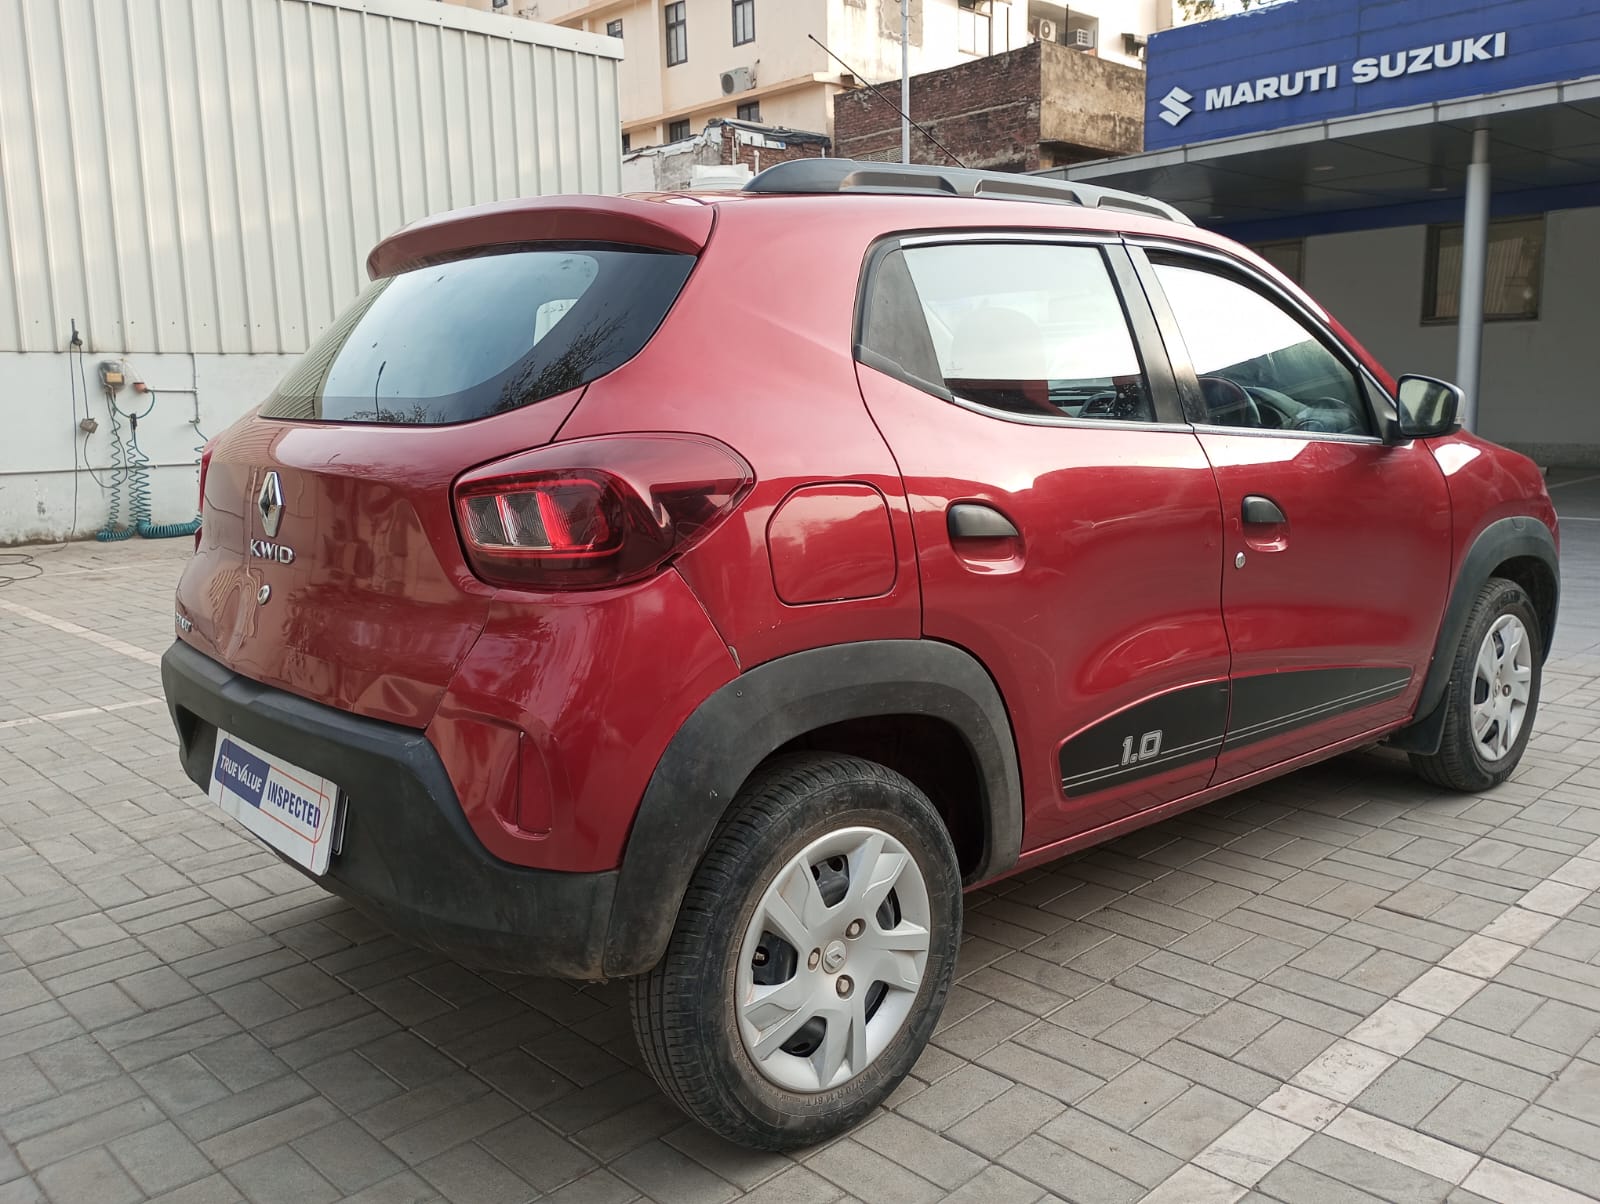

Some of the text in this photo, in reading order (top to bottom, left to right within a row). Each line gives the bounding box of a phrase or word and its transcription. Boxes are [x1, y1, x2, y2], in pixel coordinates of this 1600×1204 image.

[1204, 32, 1506, 111] MARUTI SUZUKI
[250, 538, 295, 564] KWID
[1121, 729, 1163, 766] 1.0
[267, 781, 321, 828] INSPECTED
